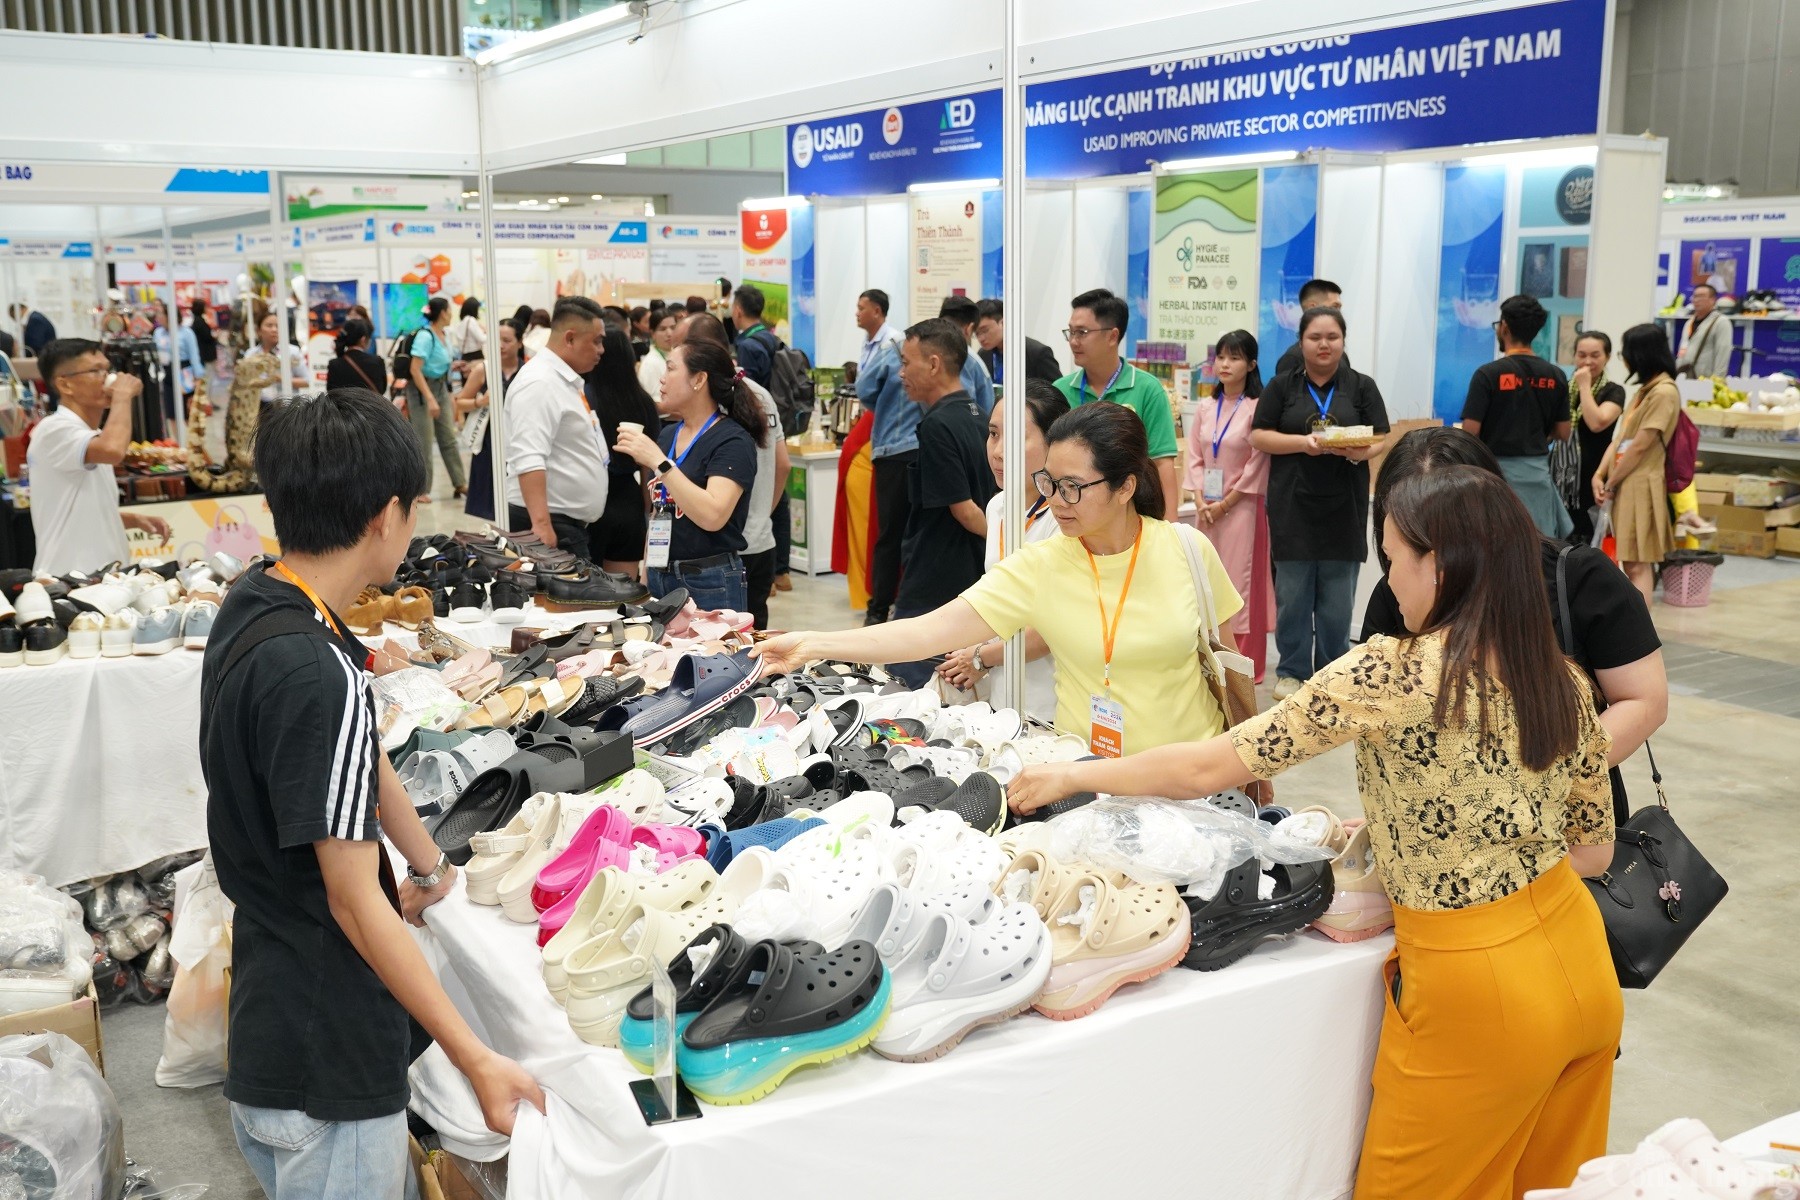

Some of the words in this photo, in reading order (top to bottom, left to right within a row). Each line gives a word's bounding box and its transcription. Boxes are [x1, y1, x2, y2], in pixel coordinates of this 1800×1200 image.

[1025, 101, 1067, 127] NĂNG
[1070, 95, 1101, 126] LỰC
[1104, 90, 1153, 121] CẠNH
[1155, 79, 1220, 110] TRANH
[1223, 72, 1266, 101] KHU
[1269, 61, 1316, 100] VỰC
[1318, 55, 1352, 89] TƯ
[1355, 47, 1426, 84] NHÂN
[1430, 36, 1489, 78] VIỆT
[1494, 28, 1562, 66] NAM
[1084, 134, 1118, 153] USAID
[1120, 126, 1188, 149] IMPROVING
[1190, 120, 1241, 142] PRIVATE
[1244, 113, 1299, 136] SECTOR
[1302, 95, 1447, 129] COMPETITIVENESS
[814, 122, 864, 152] USAID
[5, 166, 32, 180] BAG
[1195, 244, 1218, 253] HYGIE
[1195, 255, 1230, 263] PANACEE
[1187, 276, 1208, 289] FDA
[1159, 301, 1190, 311] HERBAL
[1192, 301, 1228, 311] INSTANT
[1230, 302, 1247, 312] TEA
[1499, 373, 1556, 390] ANLER
[721, 679, 751, 703] crocs
[1624, 861, 1638, 875] FURLA
